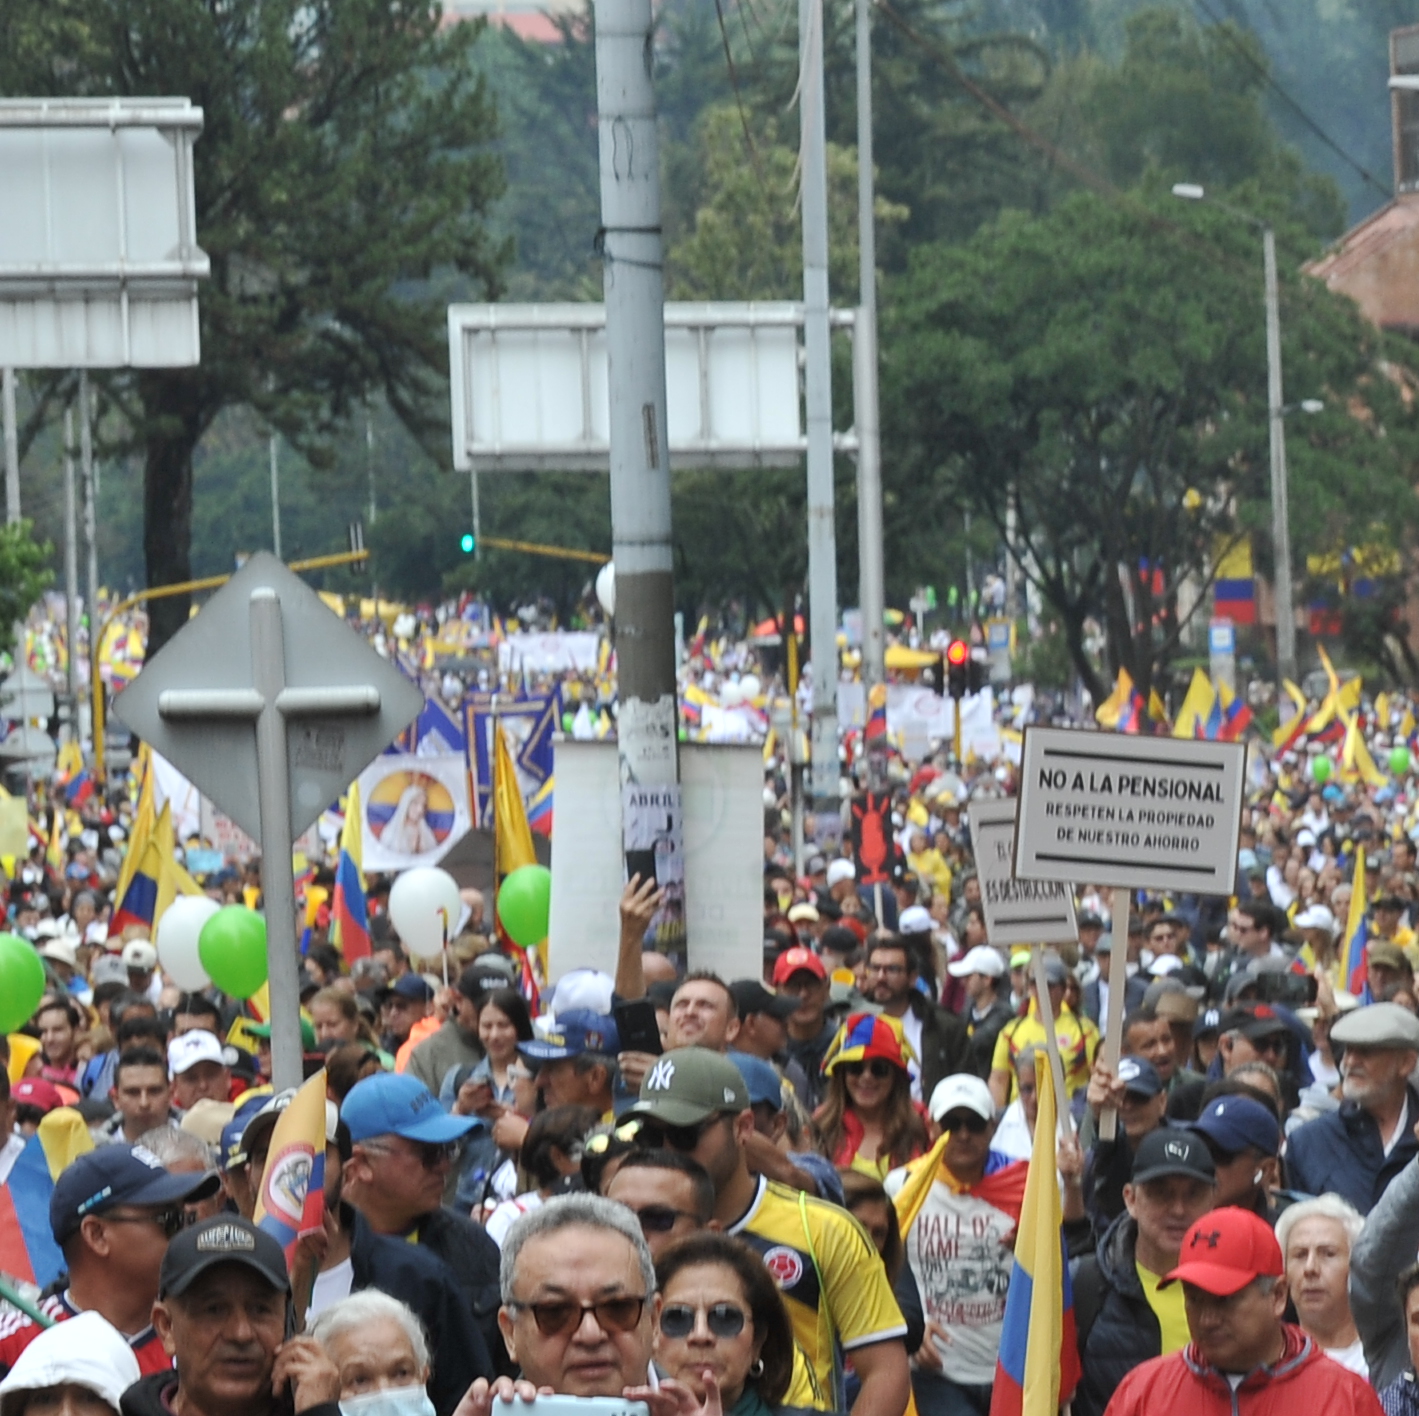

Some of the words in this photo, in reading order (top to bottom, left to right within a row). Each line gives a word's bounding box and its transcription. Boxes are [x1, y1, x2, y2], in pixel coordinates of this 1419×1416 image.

[1039, 767, 1067, 791] NO
[1071, 770, 1085, 792] A
[1089, 771, 1113, 795] LA
[1117, 774, 1225, 804] PENSIONAL
[1046, 802, 1115, 822] RESPETEN
[1118, 806, 1134, 823] LA
[1138, 808, 1215, 829] PROPIEDAD
[1057, 826, 1074, 842] DE
[1078, 828, 1140, 848] NUESTRO
[1143, 833, 1200, 851] AHORRO
[647, 1058, 676, 1092] NY
